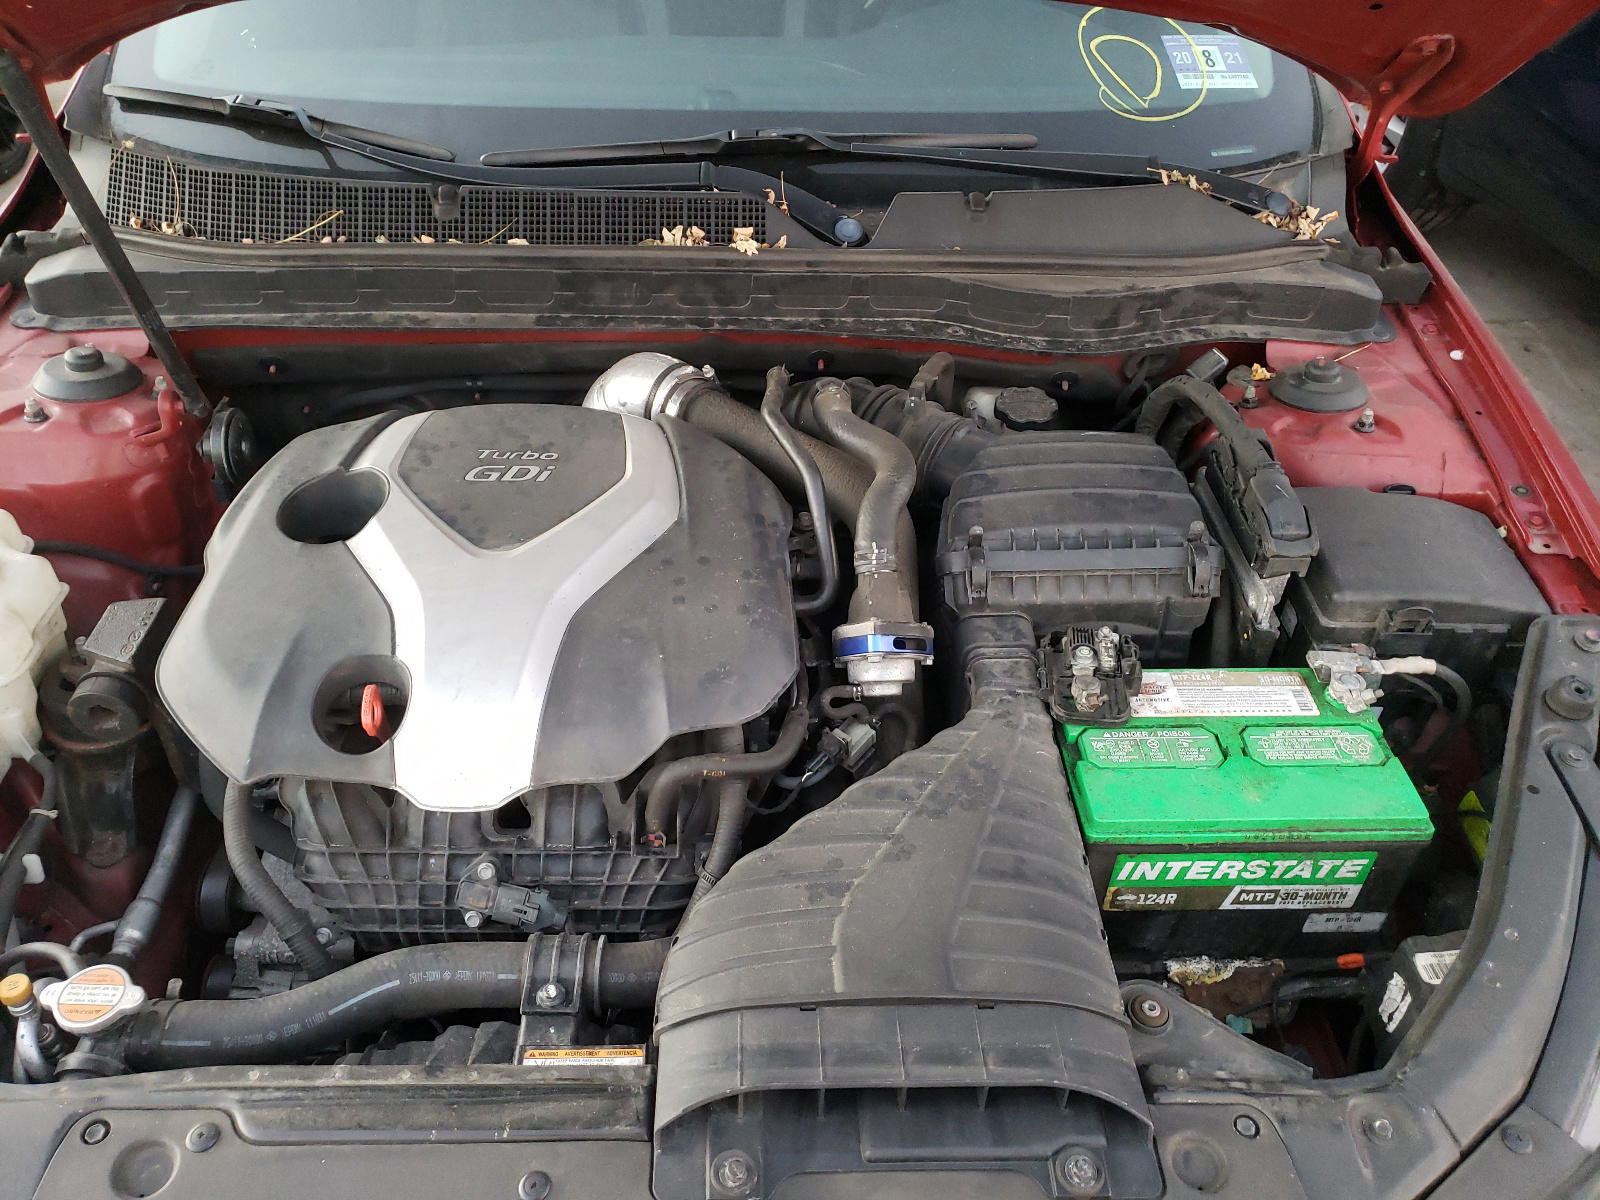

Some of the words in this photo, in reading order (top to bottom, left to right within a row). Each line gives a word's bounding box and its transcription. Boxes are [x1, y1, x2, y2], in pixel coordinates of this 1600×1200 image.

[1172, 51, 1193, 64] 20
[1201, 49, 1216, 68] 8
[1224, 51, 1243, 64] 21
[477, 449, 559, 460] Turbo
[464, 465, 556, 482] GDi
[1116, 859, 1370, 881] INTERSTATE
[1136, 893, 1178, 905] 124R
[1239, 893, 1275, 902] MTP
[1281, 892, 1348, 901] 30-MONTH
